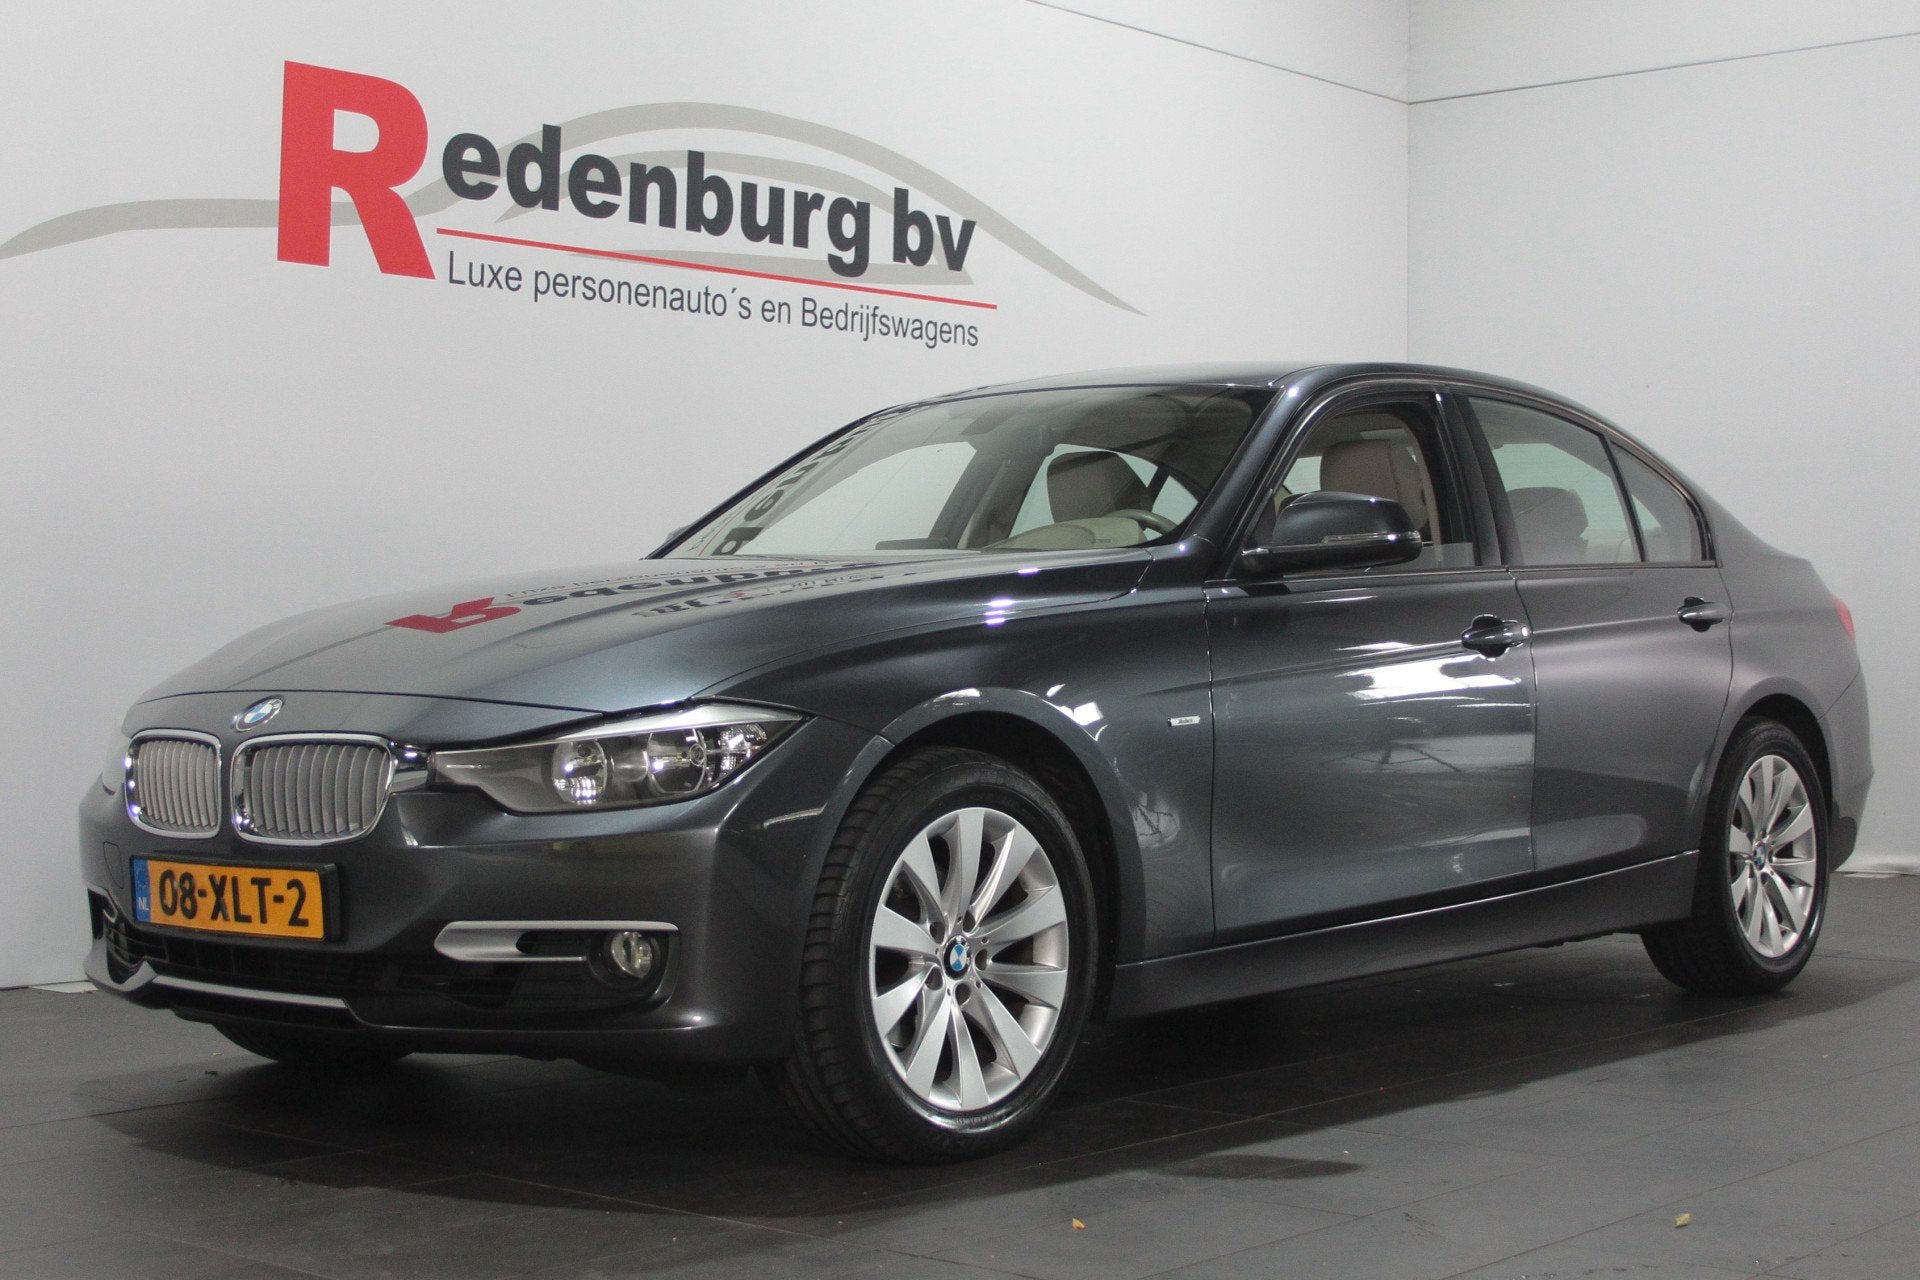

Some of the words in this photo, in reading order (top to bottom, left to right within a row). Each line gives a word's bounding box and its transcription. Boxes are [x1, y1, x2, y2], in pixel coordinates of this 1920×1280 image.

[277, 60, 870, 279] Redenburg
[893, 186, 977, 272] bv
[448, 250, 523, 292] Luxe
[761, 298, 792, 325] en
[801, 296, 979, 349] Bedrijfswagens
[138, 896, 150, 911] NL
[159, 869, 309, 927] 08-XLT-2
